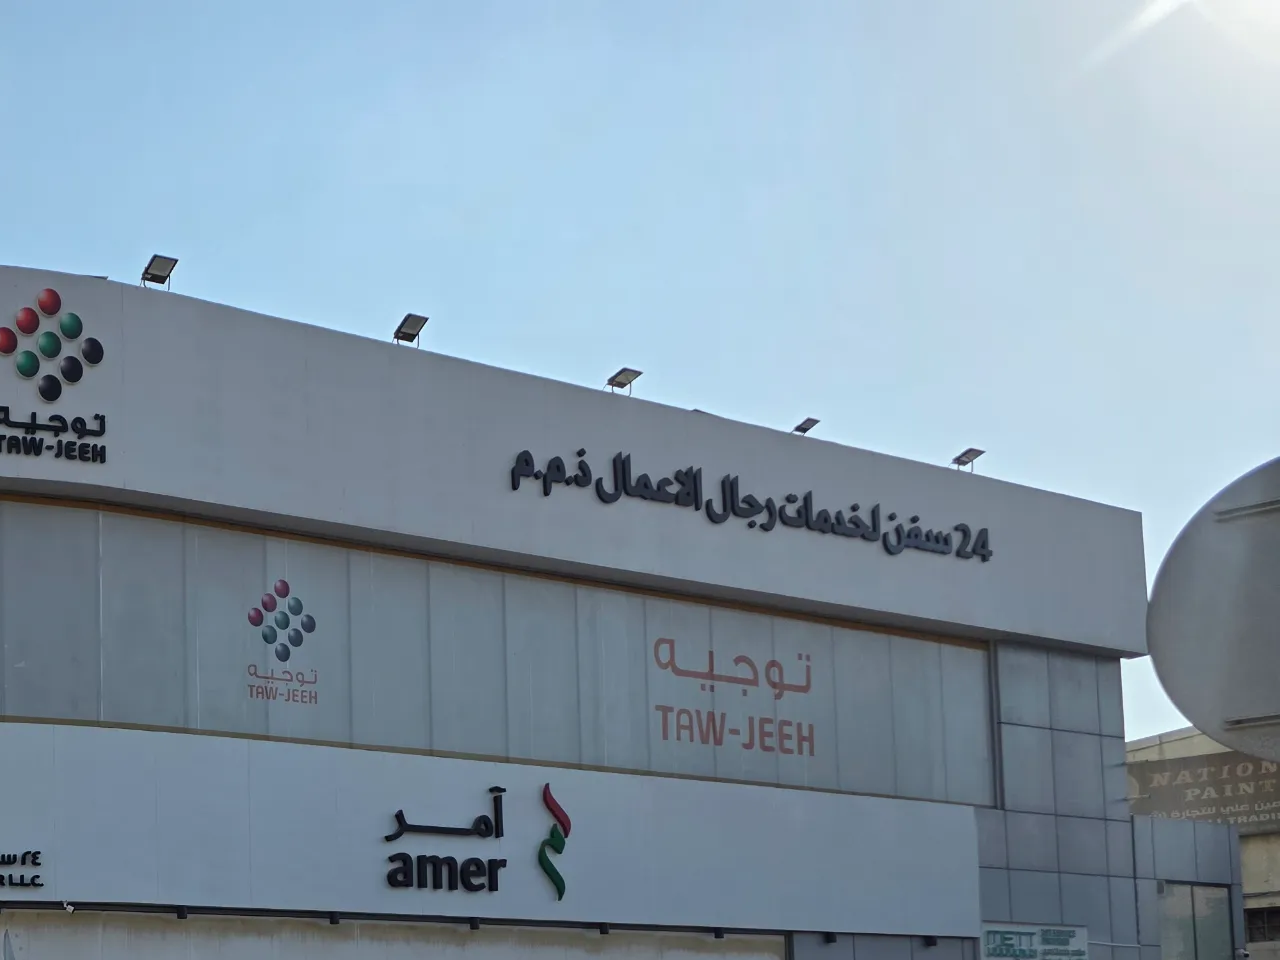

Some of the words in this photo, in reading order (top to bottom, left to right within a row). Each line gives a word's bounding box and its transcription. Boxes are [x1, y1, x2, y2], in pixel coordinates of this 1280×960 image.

[954, 522, 993, 563] 24
[247, 684, 318, 704] TAW-JEEH
[654, 704, 815, 756] TAW-JEEH
[386, 850, 507, 893] amer
